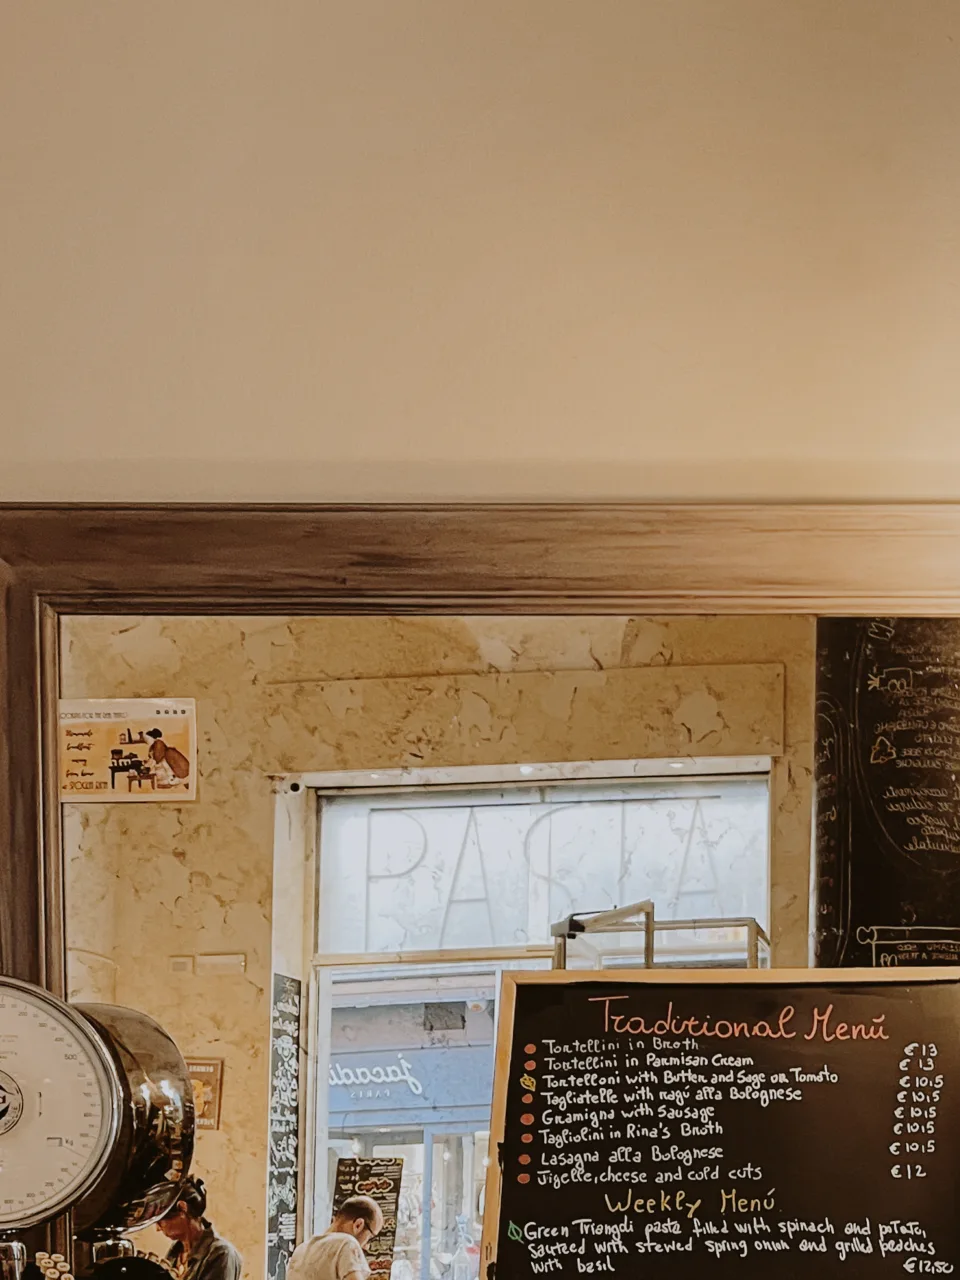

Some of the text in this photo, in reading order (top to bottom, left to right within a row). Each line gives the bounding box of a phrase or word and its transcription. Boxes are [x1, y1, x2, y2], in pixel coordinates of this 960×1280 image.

[588, 995, 796, 1039] Traditional
[542, 1037, 698, 1054] Tortellini in Broth
[544, 1054, 618, 1070] Tortellini
[625, 1054, 639, 1067] in
[712, 1054, 753, 1067] Cream
[542, 1071, 620, 1088] Tortelloni
[626, 1070, 658, 1084] with
[711, 1070, 735, 1084] and
[737, 1072, 766, 1090] Sage
[790, 1064, 838, 1083] Tomato
[540, 1089, 618, 1110] Tagliatelle
[624, 1086, 654, 1102] with
[695, 1087, 723, 1101] alla
[730, 1088, 802, 1107] Bolognese
[542, 1104, 715, 1128] Gramigna with Sausage
[538, 1126, 604, 1149] Tagliolini
[610, 1126, 621, 1139] in
[680, 1121, 723, 1137] Broth
[541, 1145, 724, 1170] Lasagna alla Bolognese
[655, 1163, 763, 1183] and cold cuts
[604, 1188, 702, 1218] Weekly
[524, 1222, 569, 1240] Green
[693, 1218, 728, 1237] filled
[734, 1217, 771, 1235] with
[778, 1217, 834, 1239] spinach
[844, 1217, 871, 1236] and
[594, 1239, 628, 1254] with
[635, 1237, 693, 1253] stewed
[705, 1240, 748, 1258] spring
[799, 1236, 827, 1252] and
[835, 1237, 874, 1261] grilled
[880, 1238, 936, 1257] peaches
[531, 1258, 562, 1274] with
[577, 1255, 615, 1273] basil
